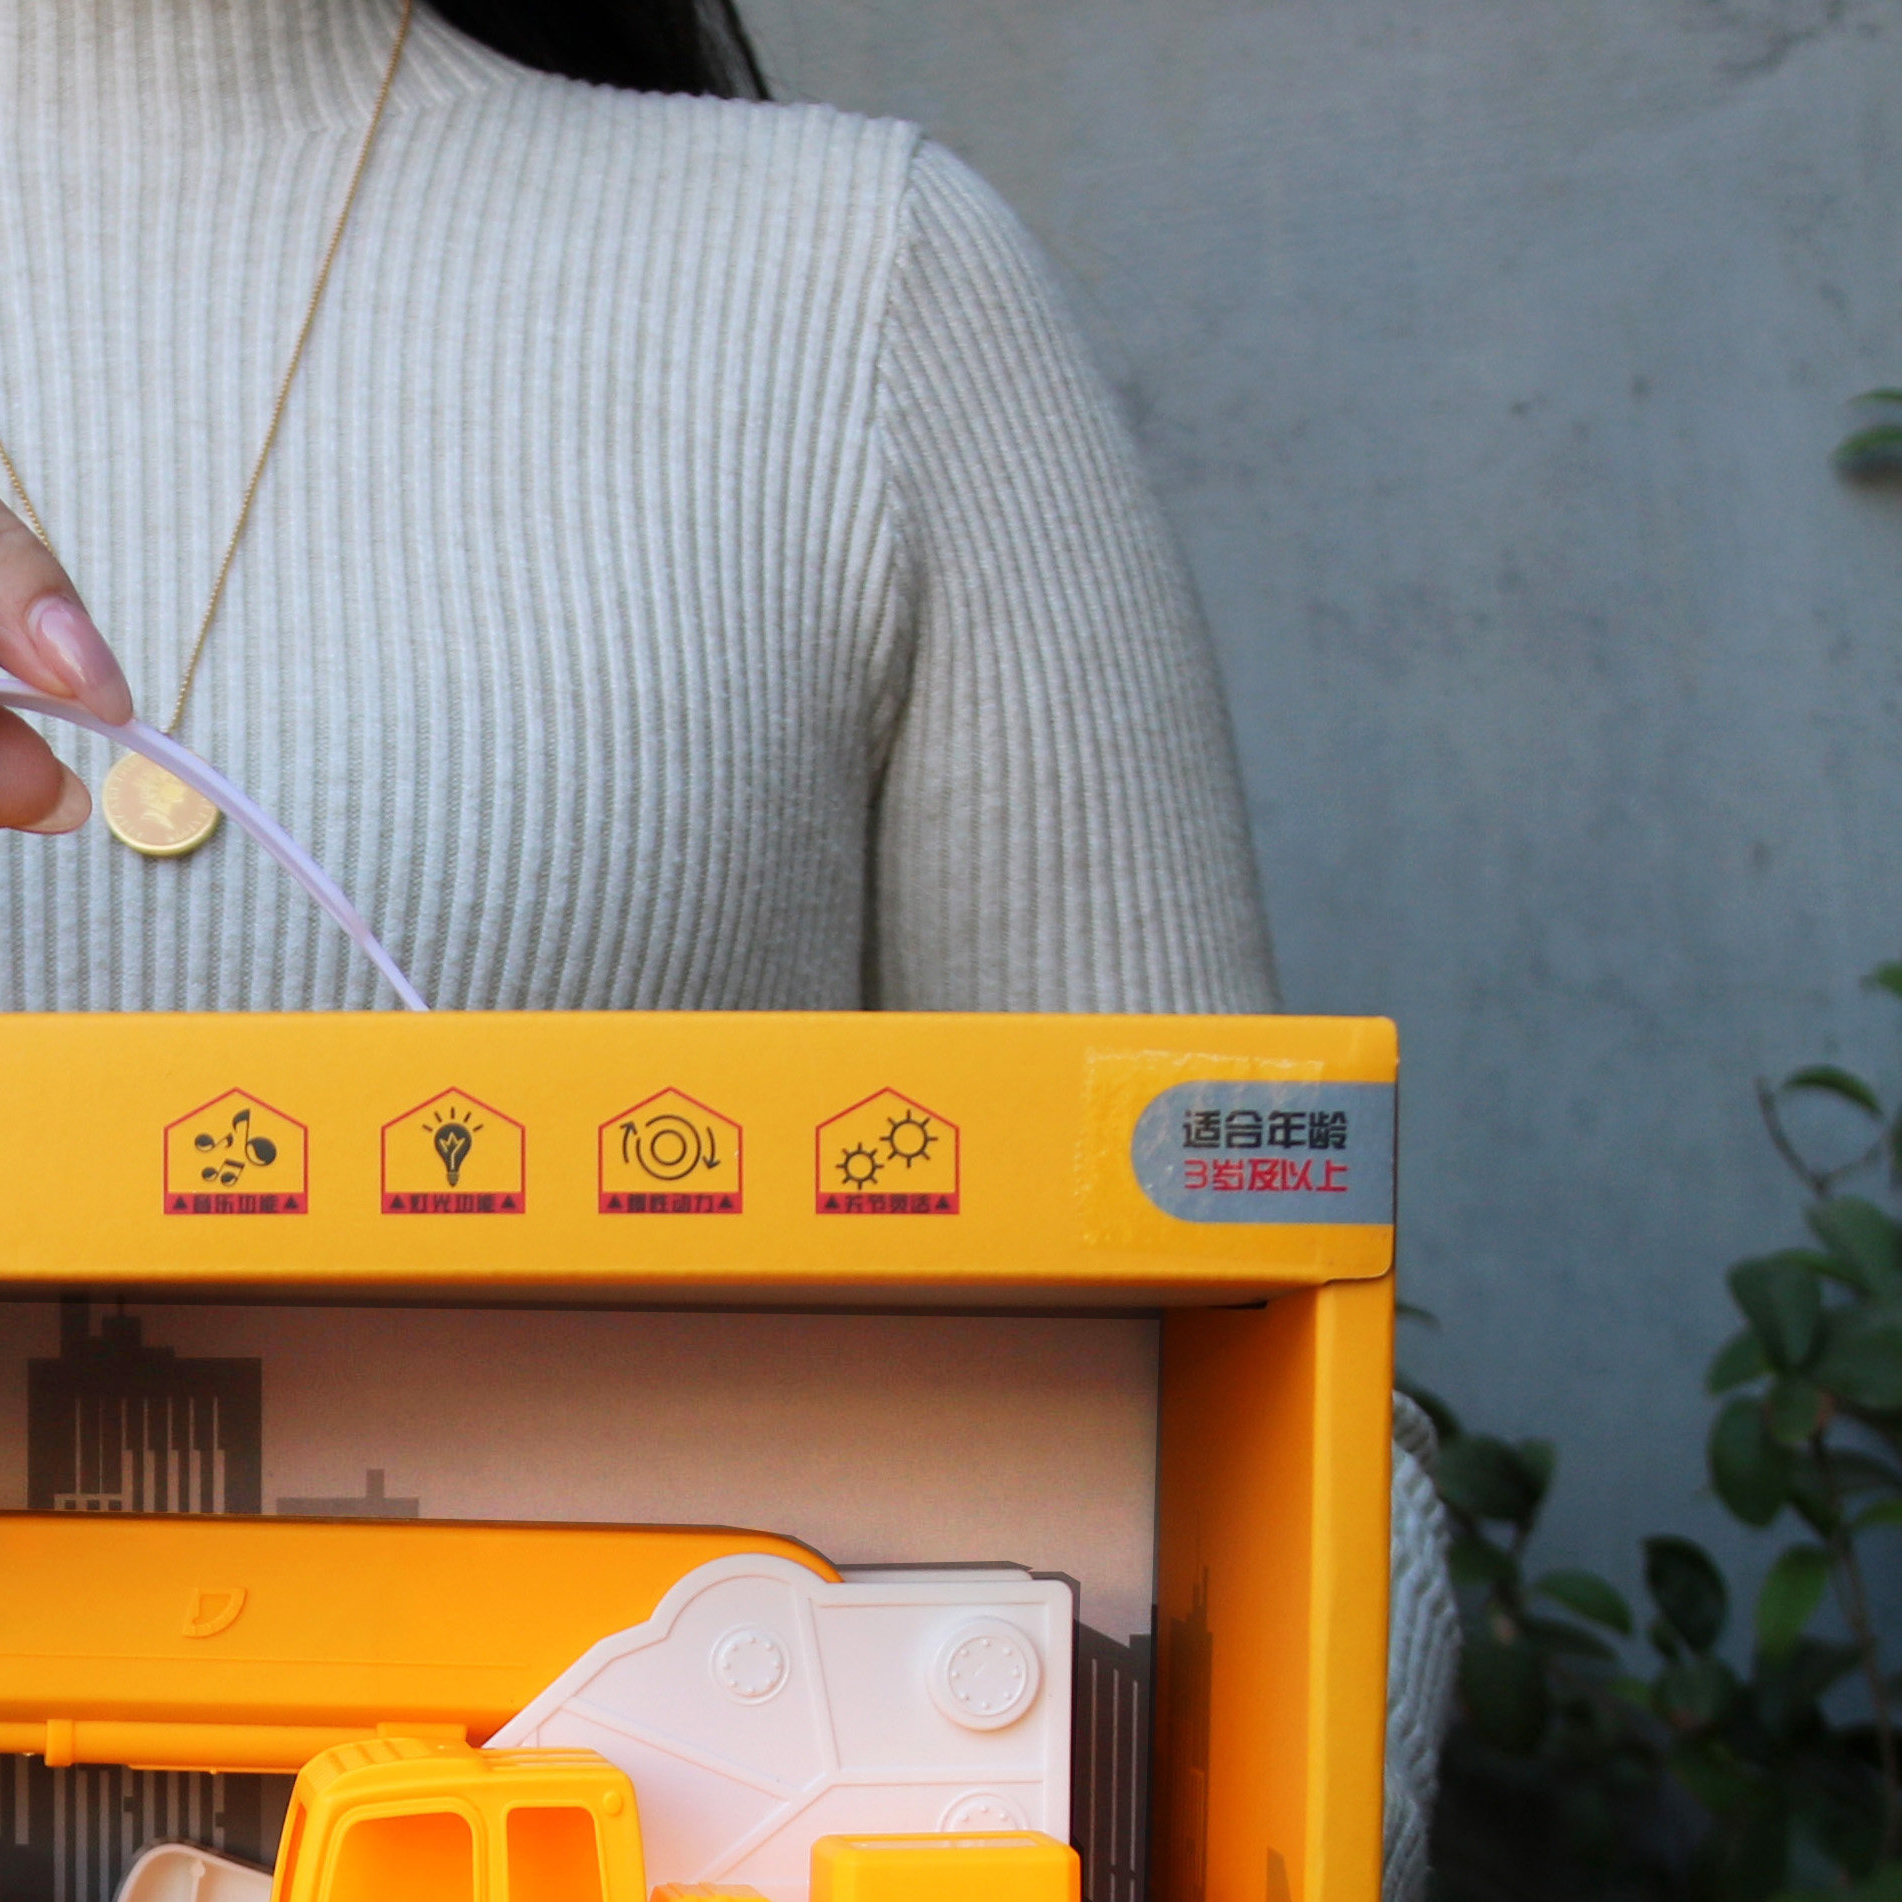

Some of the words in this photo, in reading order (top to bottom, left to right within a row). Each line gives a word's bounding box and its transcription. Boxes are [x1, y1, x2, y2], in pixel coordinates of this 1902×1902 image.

[1182, 1109, 1347, 1150] 适合年龄
[1184, 1158, 1347, 1192] 3岁及以上
